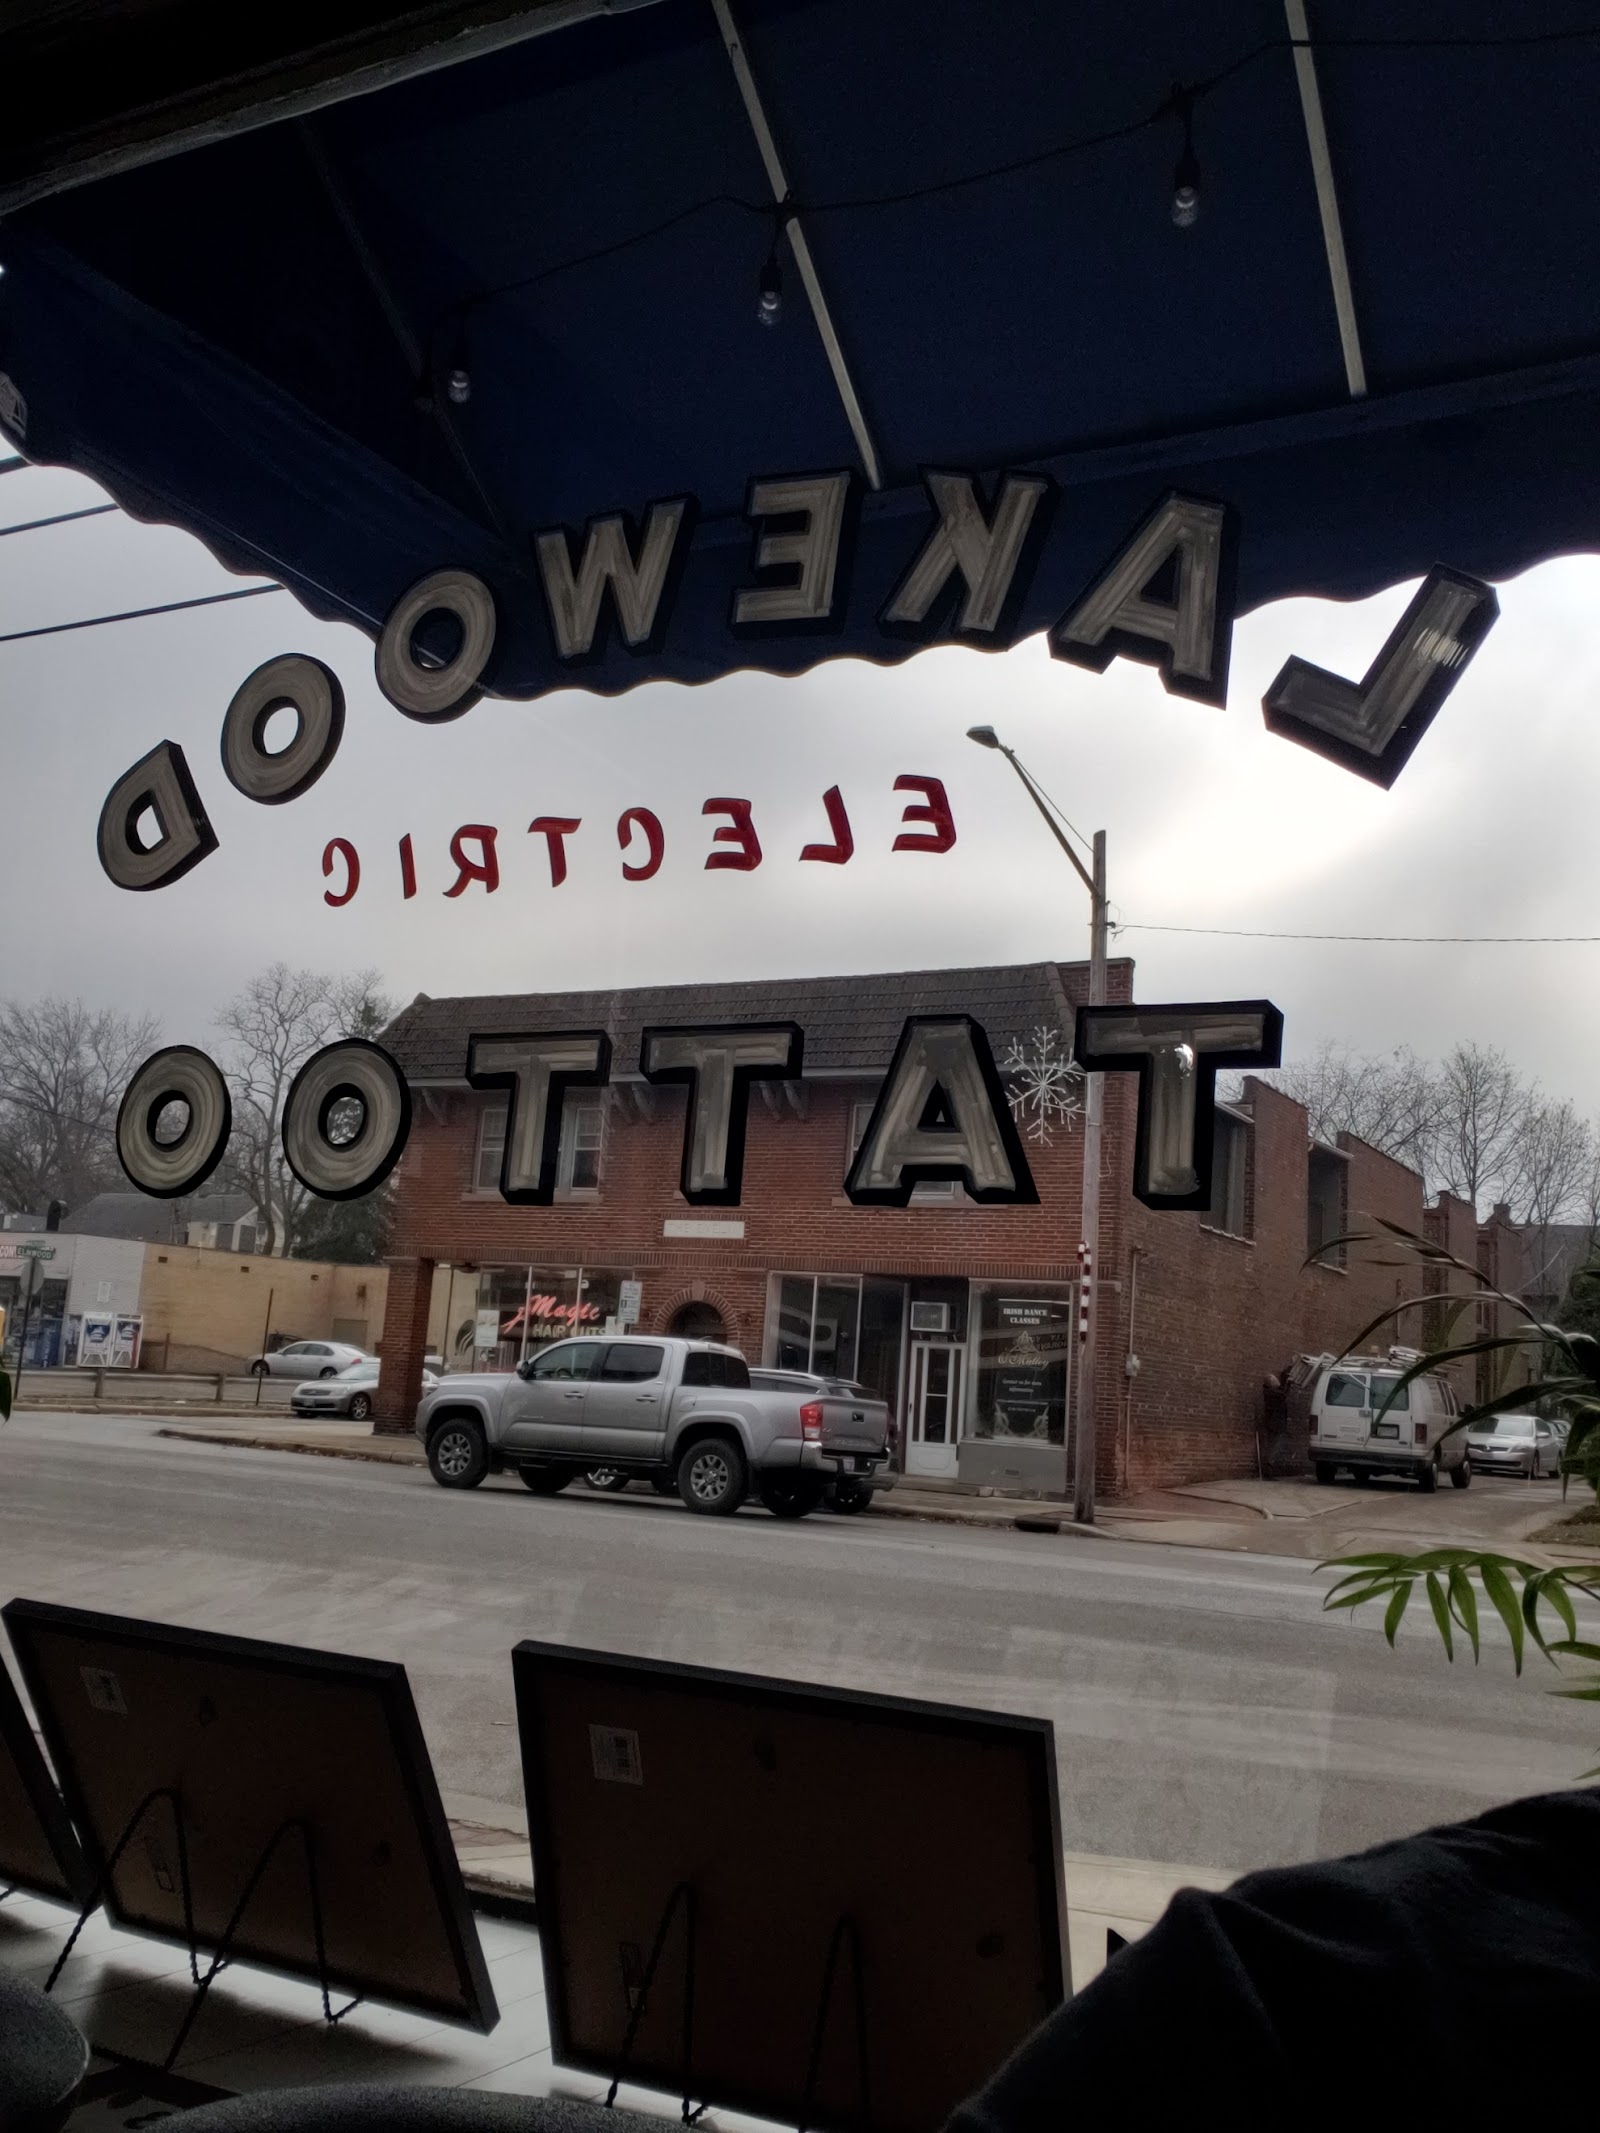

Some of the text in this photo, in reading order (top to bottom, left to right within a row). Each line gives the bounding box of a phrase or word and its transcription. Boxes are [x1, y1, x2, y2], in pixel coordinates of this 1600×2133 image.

[1024, 1308, 1047, 1316] DANCE
[1010, 1317, 1040, 1325] CLASSES
[532, 1324, 566, 1338] HAIR
